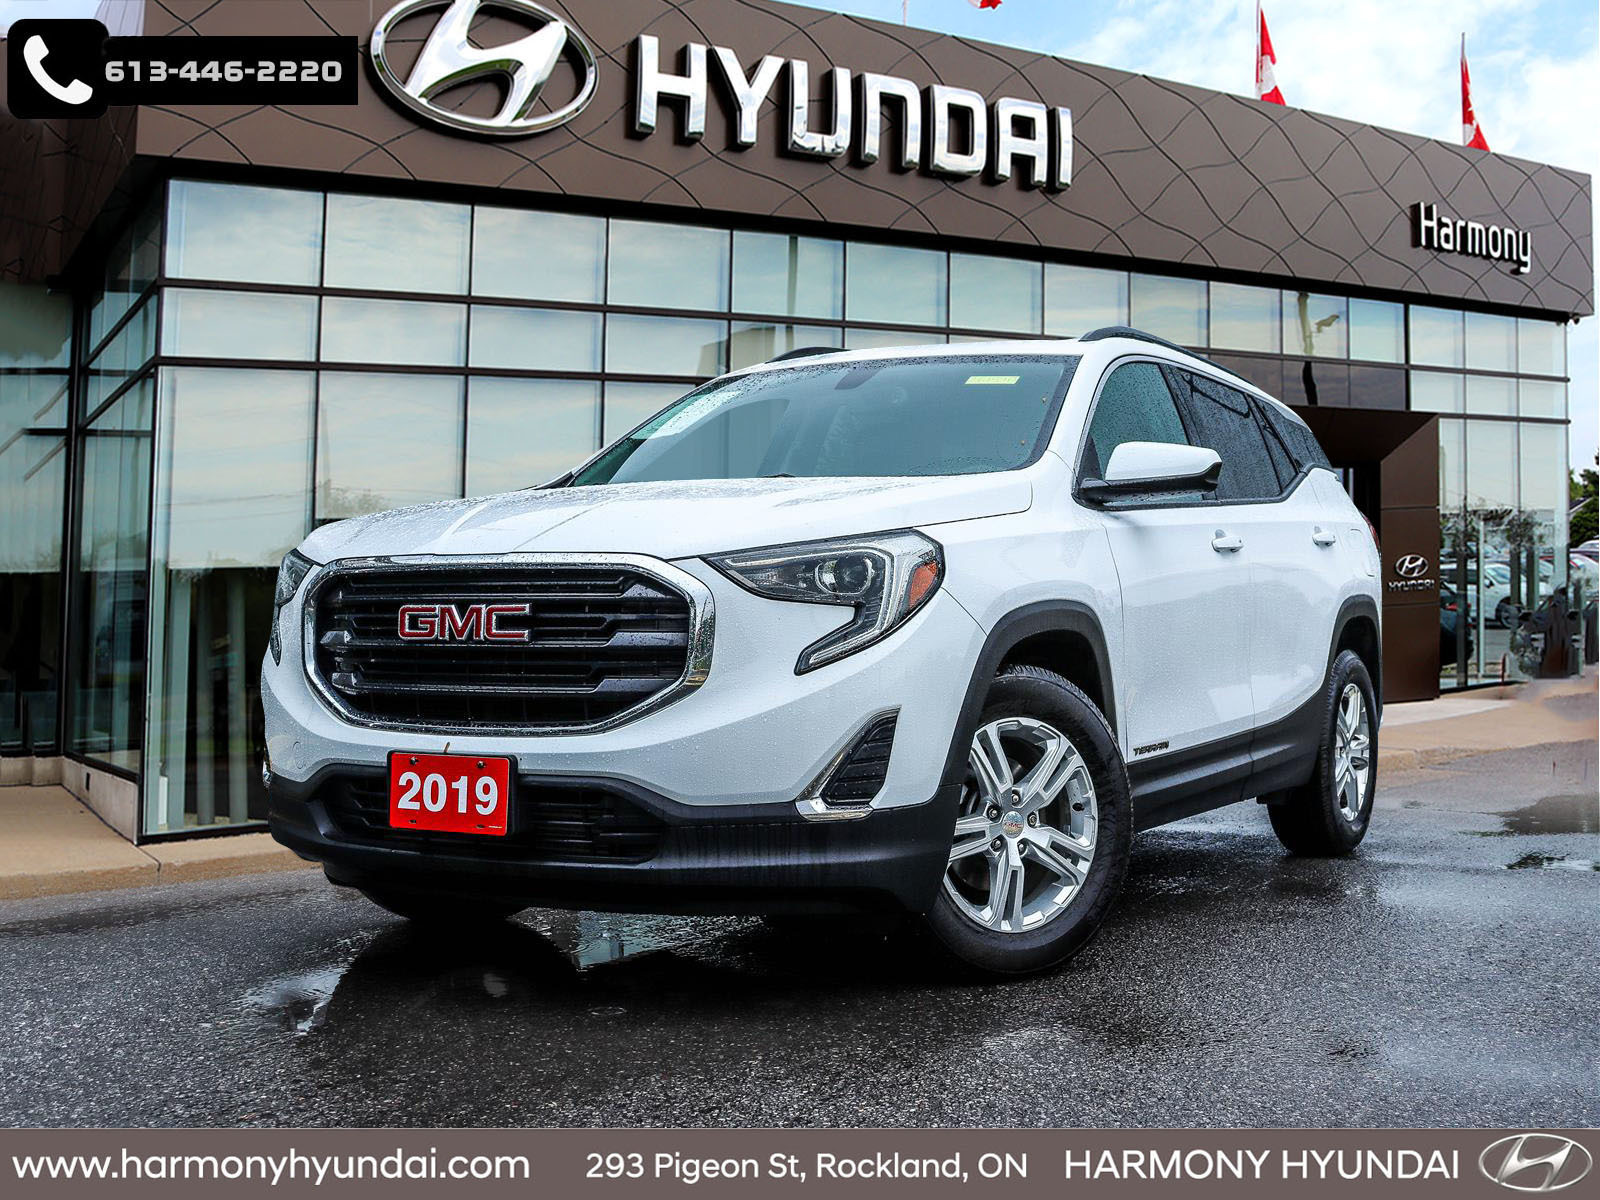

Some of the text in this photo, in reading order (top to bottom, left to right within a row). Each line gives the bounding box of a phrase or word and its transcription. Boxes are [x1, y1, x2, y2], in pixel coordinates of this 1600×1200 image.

[635, 34, 1074, 191] HYUNDAI
[1418, 201, 1532, 274] Harmony
[1388, 579, 1435, 592] HYUNDAI
[397, 603, 530, 642] GMC
[397, 771, 499, 816] 2019
